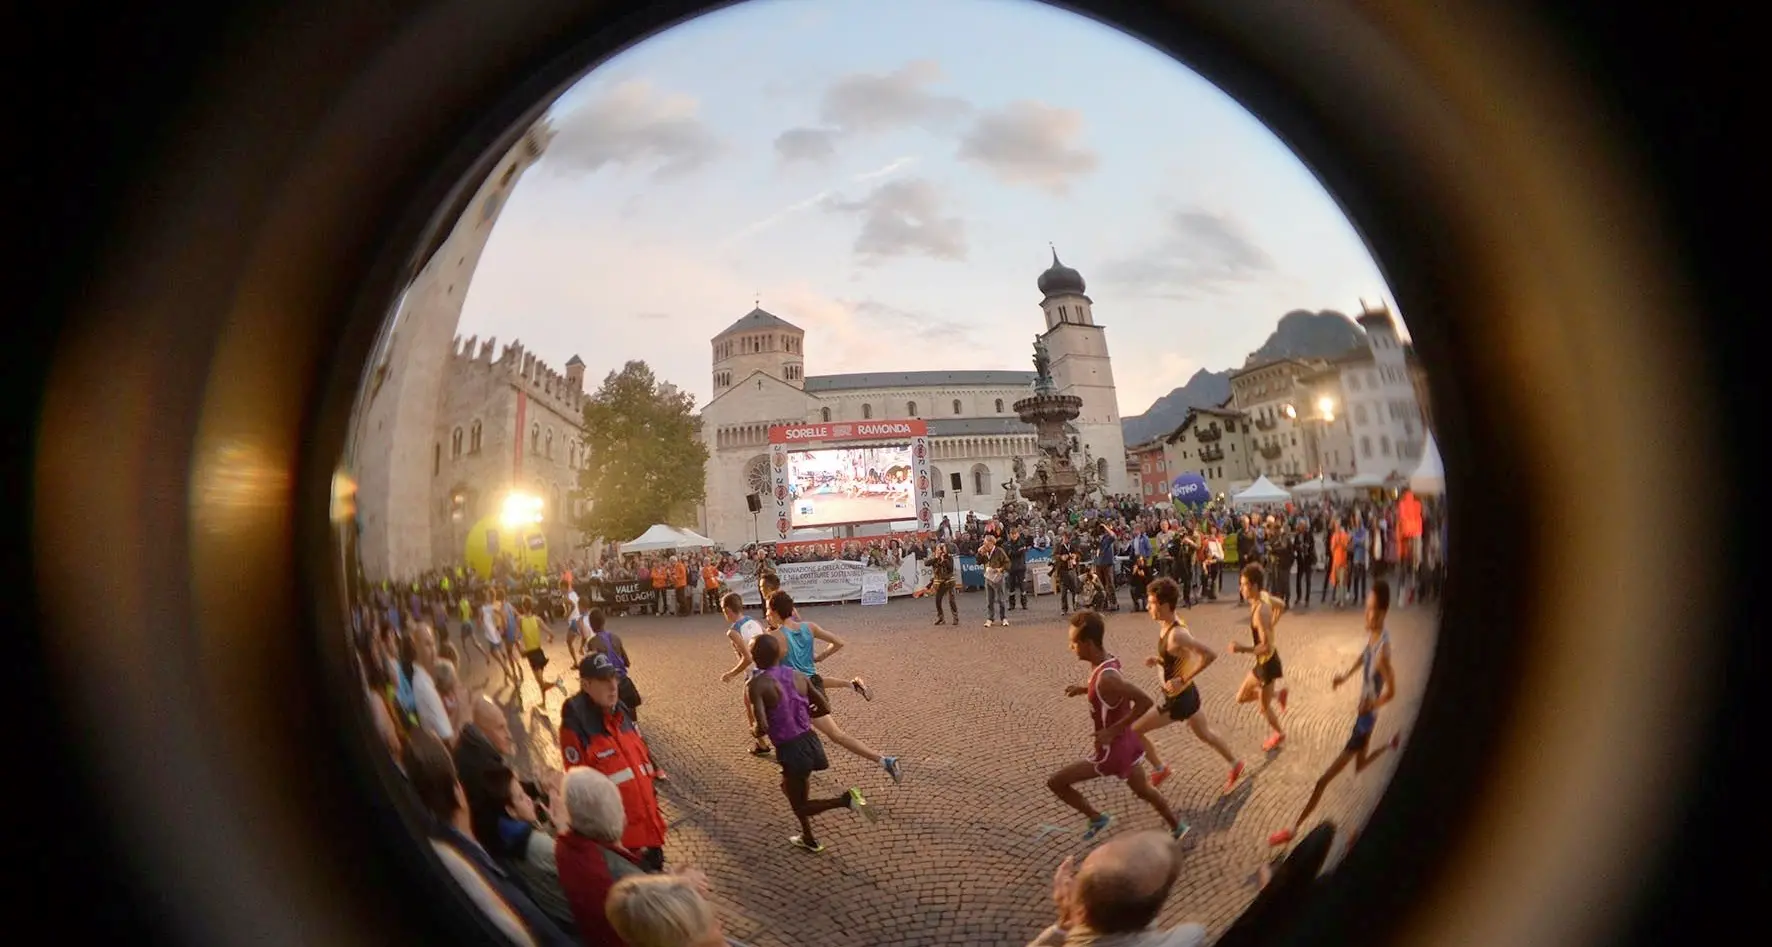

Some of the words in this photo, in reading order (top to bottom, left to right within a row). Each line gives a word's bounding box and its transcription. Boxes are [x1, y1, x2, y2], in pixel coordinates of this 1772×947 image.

[785, 427, 828, 439] SORELLE
[857, 423, 911, 435] RAMONDA
[616, 583, 641, 594] VALLE
[631, 589, 656, 602] LAGHI
